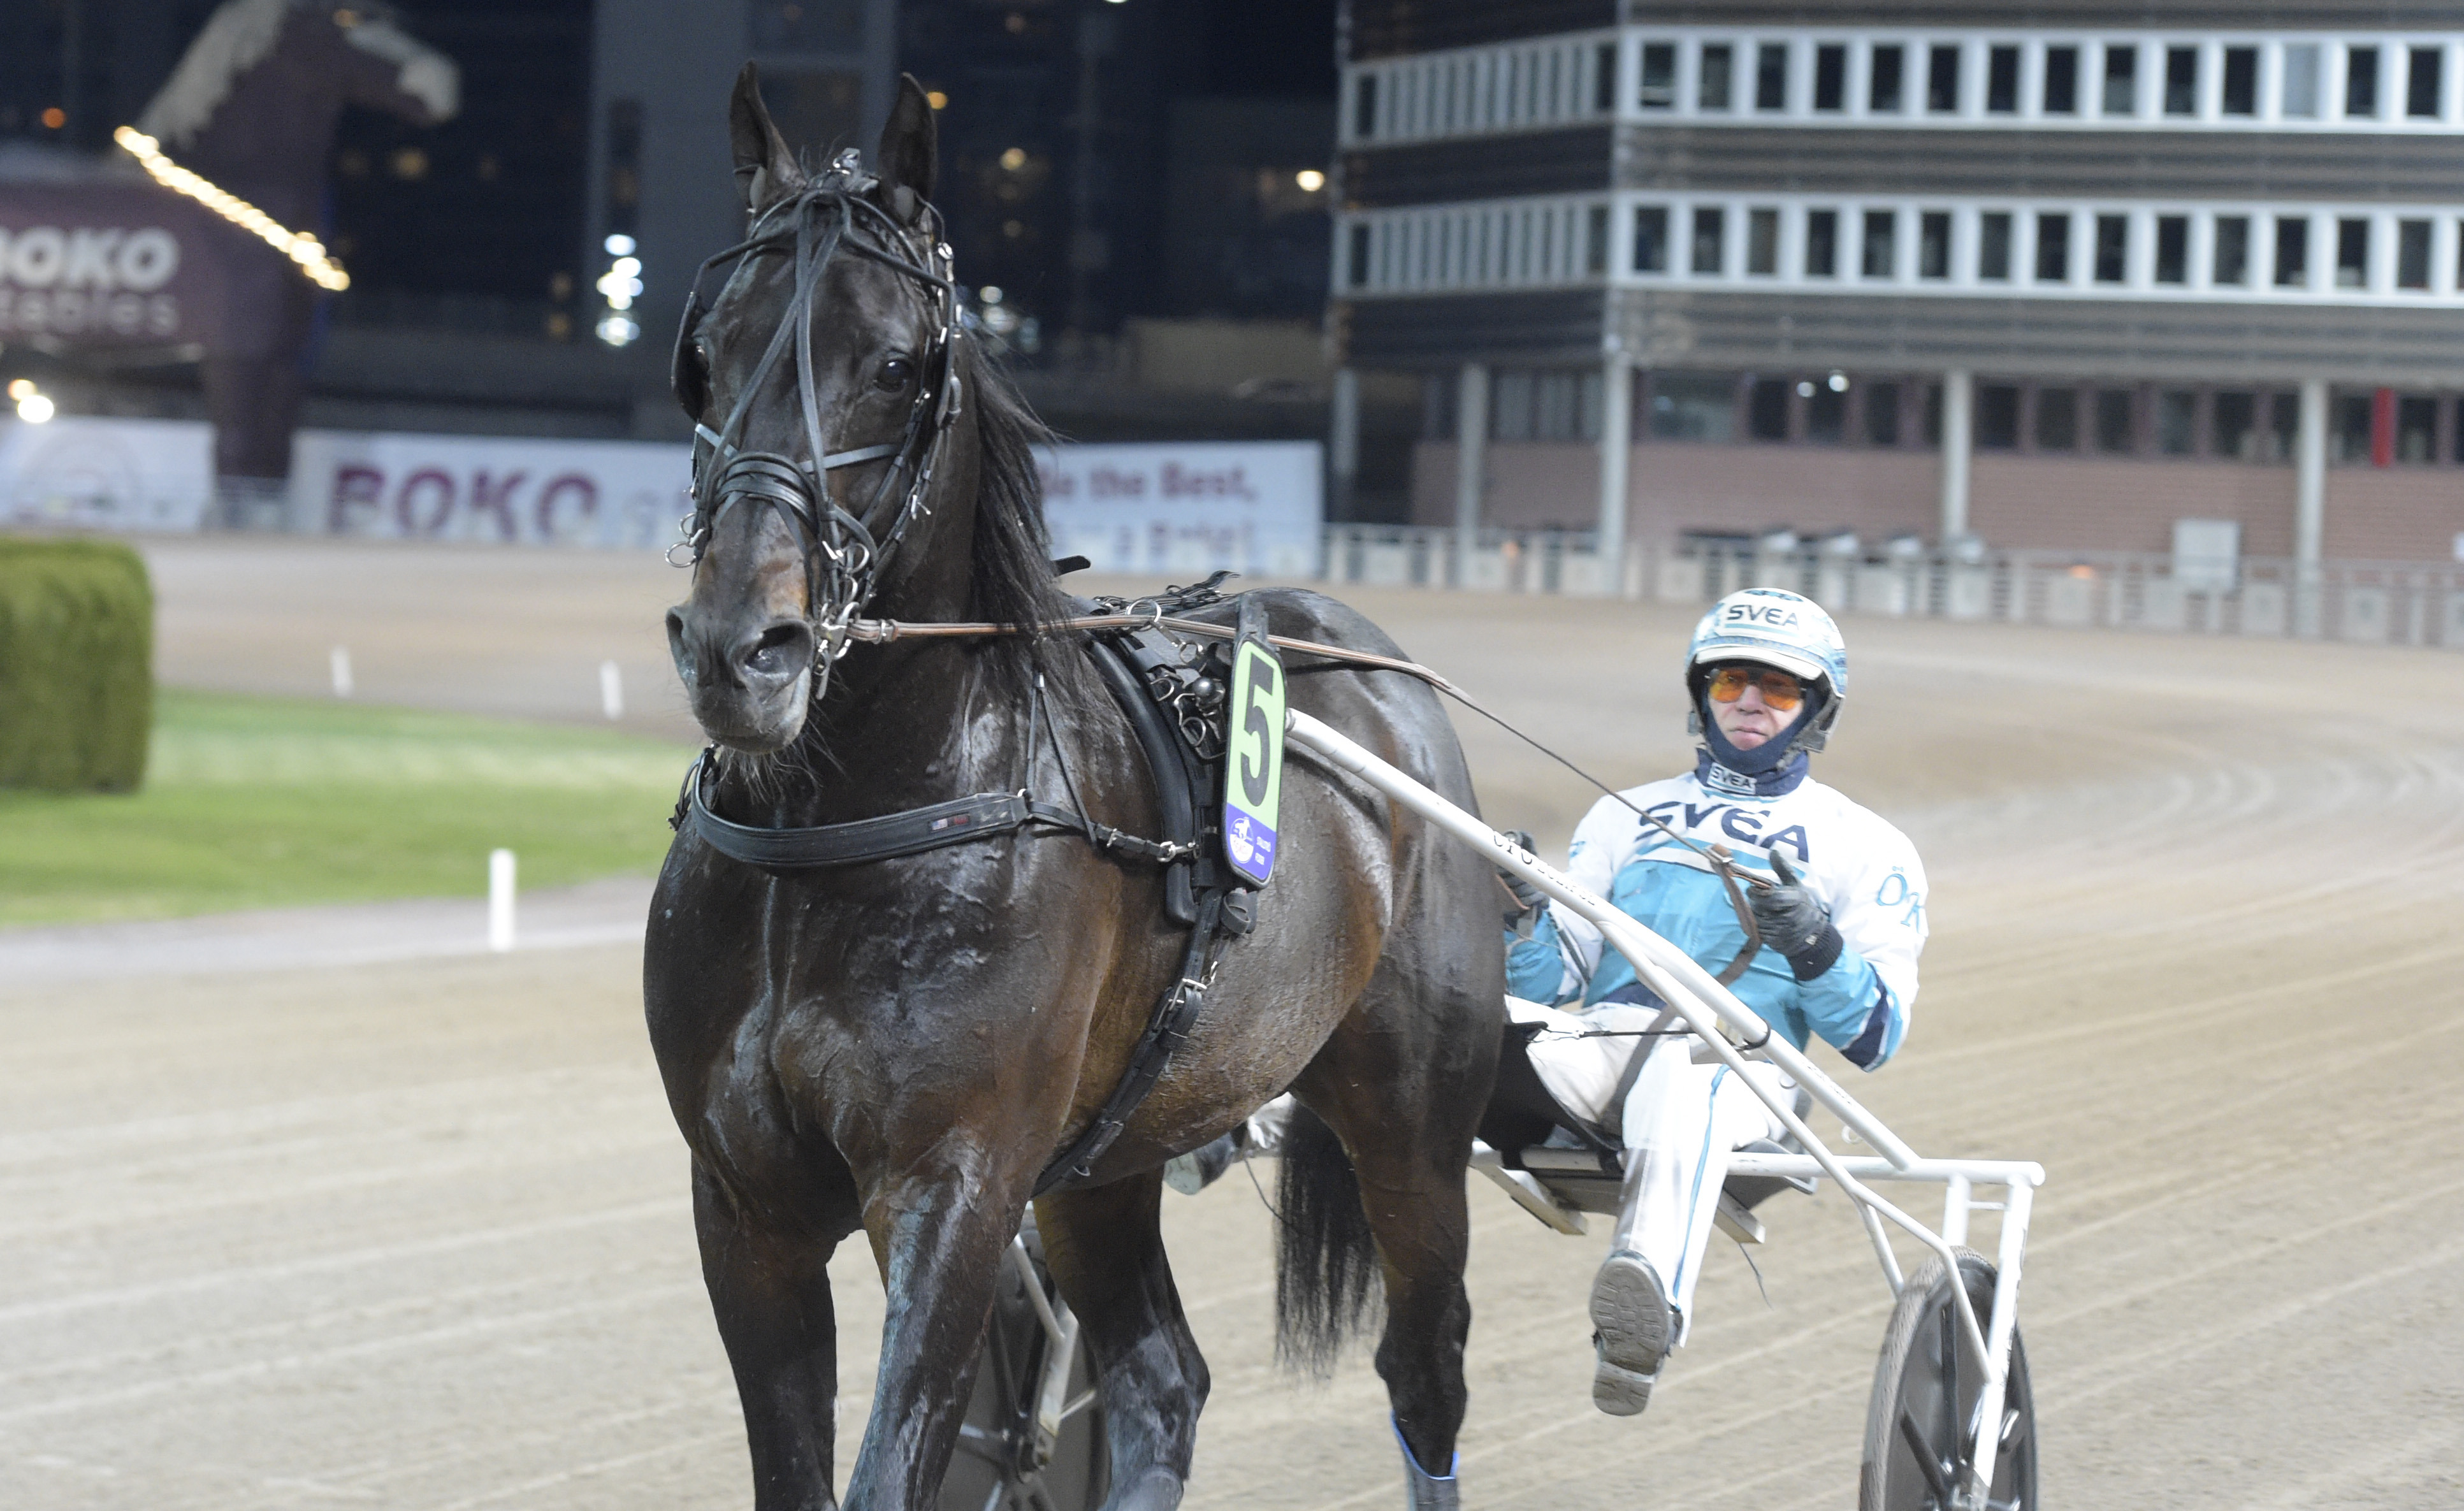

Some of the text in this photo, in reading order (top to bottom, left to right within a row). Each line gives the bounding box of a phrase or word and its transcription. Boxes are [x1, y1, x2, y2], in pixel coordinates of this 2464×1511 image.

[0, 226, 179, 291] OKO
[1727, 604, 1799, 631] SVEA
[1240, 651, 1275, 807] 5
[1711, 766, 1751, 788] SVEA
[1635, 800, 1809, 864] SVEA
